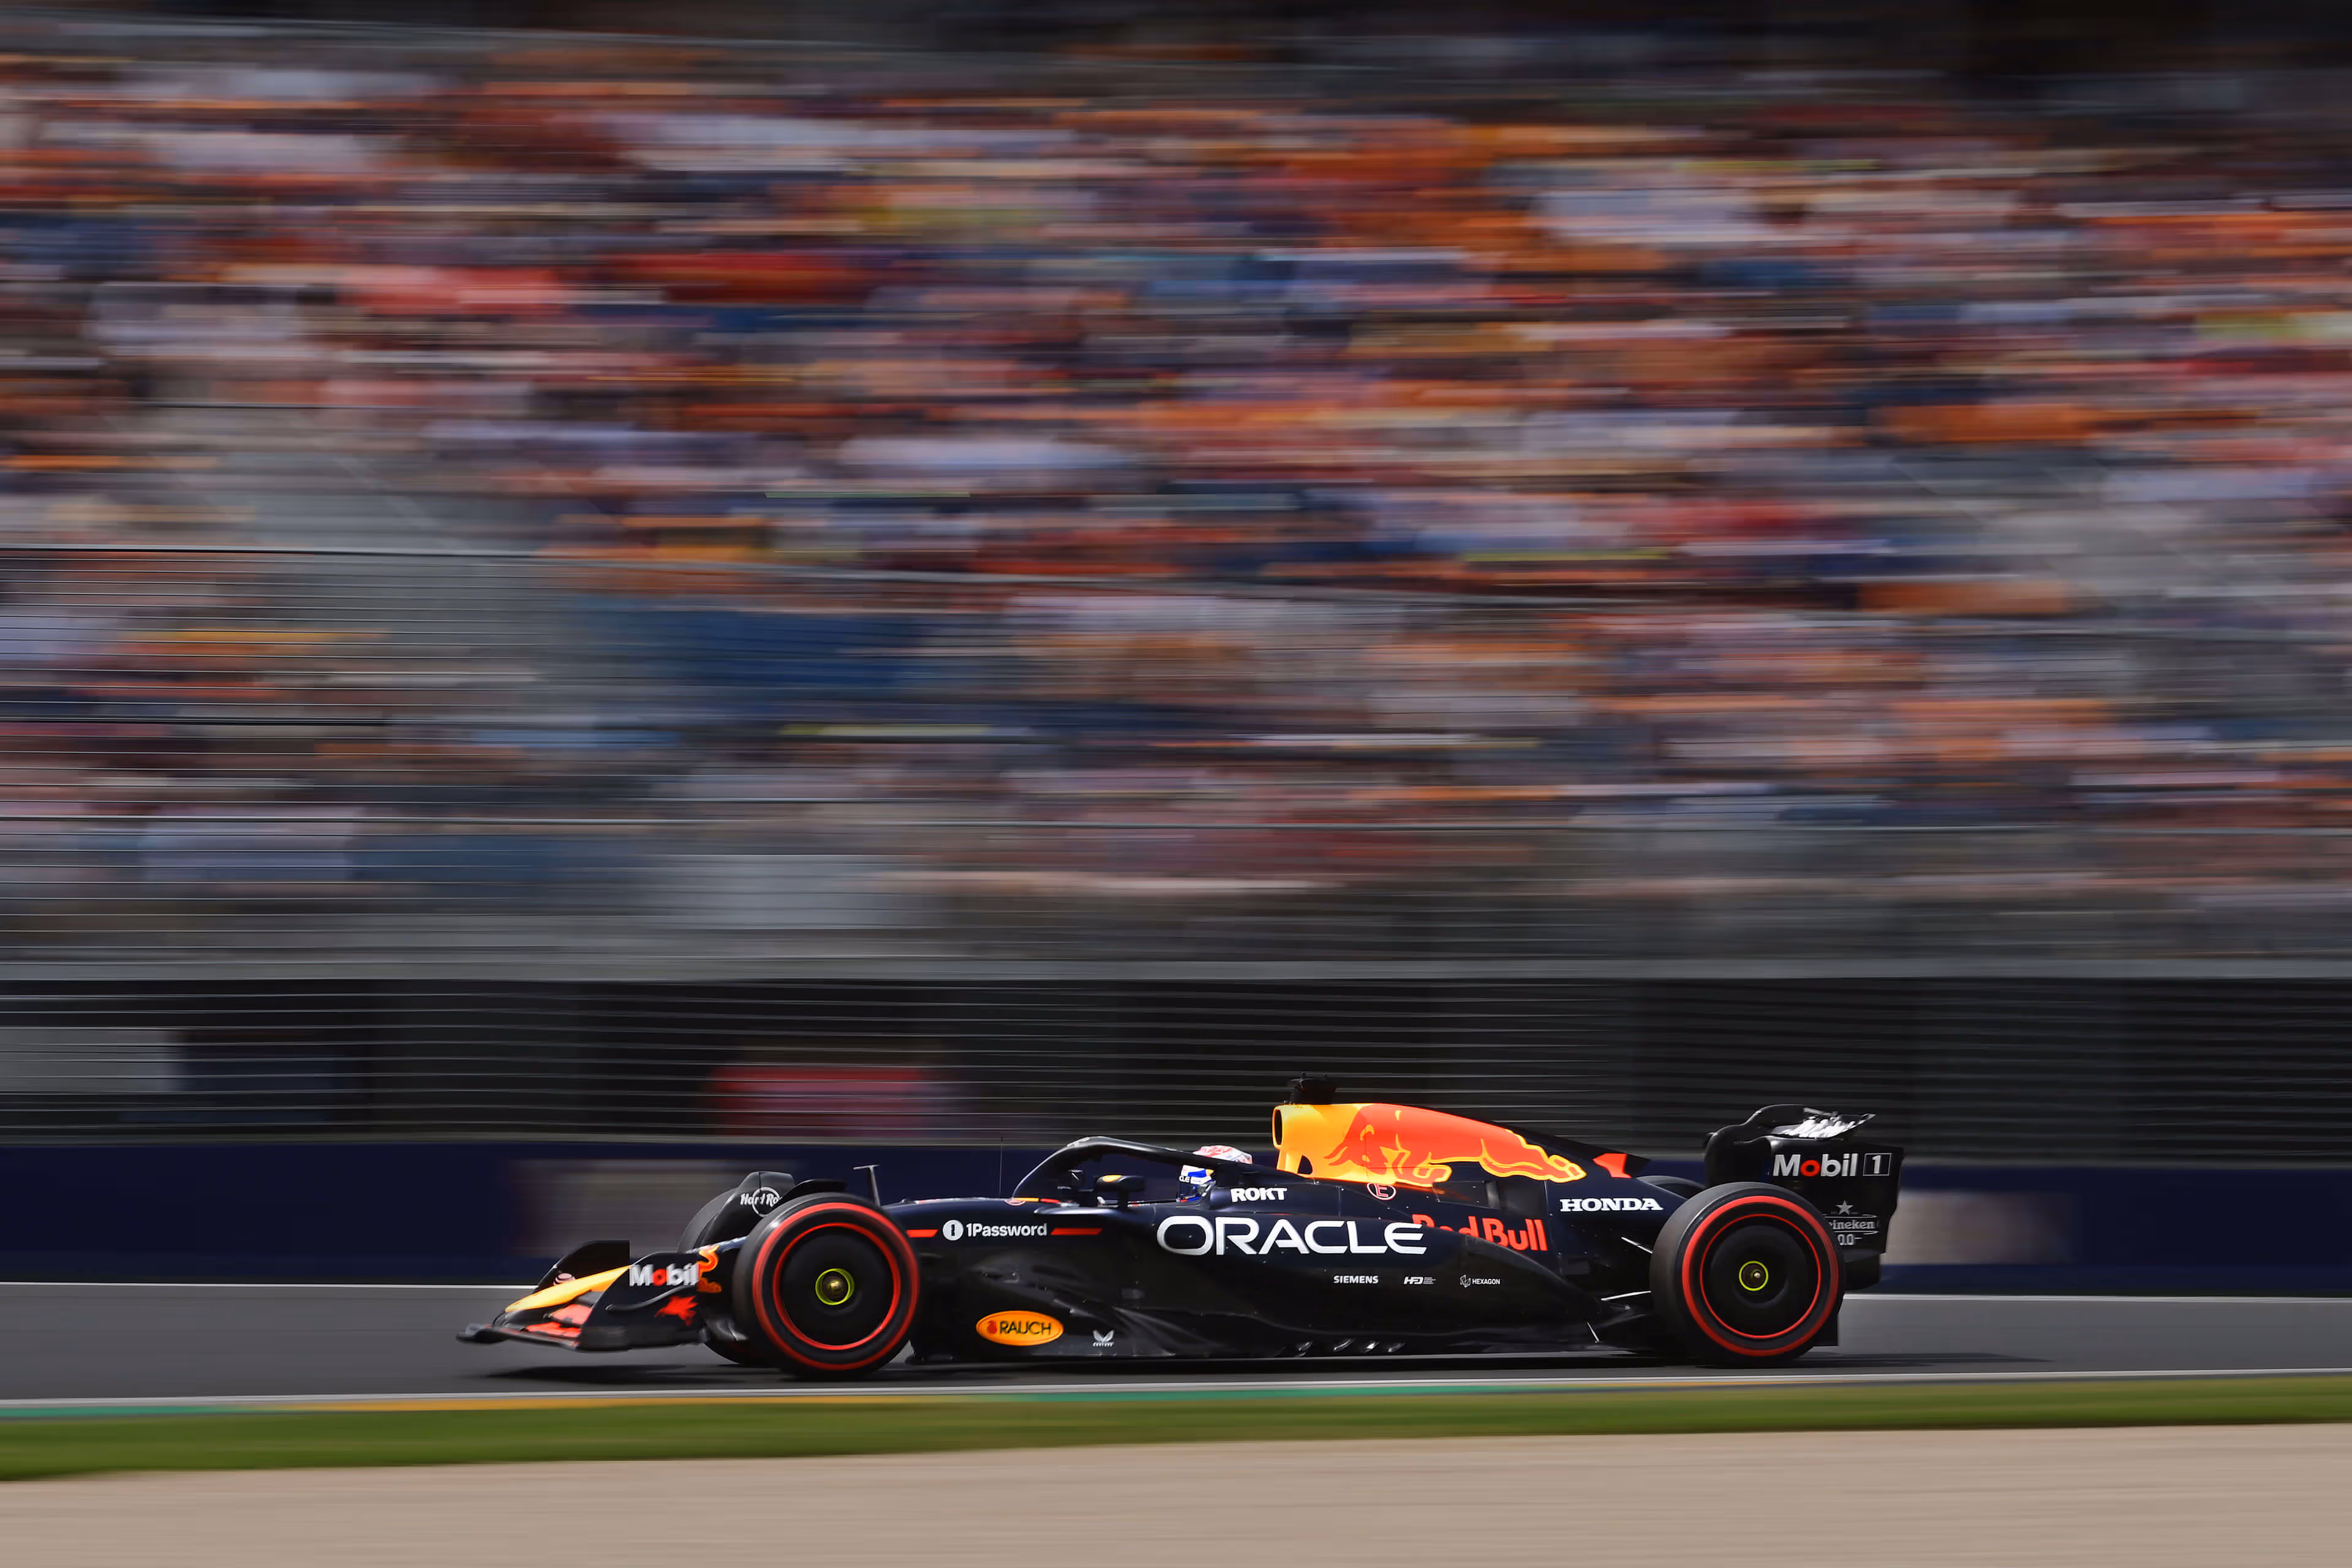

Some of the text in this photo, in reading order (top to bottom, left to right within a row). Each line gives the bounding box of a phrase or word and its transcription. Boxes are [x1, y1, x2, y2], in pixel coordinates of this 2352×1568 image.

[1773, 1153, 1858, 1177] Mobil
[766, 1193, 783, 1207] Ro
[1231, 1188, 1287, 1202] ROKT
[1559, 1198, 1664, 1212] HONDA
[966, 1223, 1047, 1237] 1Password
[1829, 1219, 1875, 1230] ineken
[1157, 1215, 1427, 1256] ORACLE
[1482, 1218, 1548, 1251] Bull
[629, 1263, 699, 1286] Mobil
[1000, 1321, 1051, 1335] RAUCH
